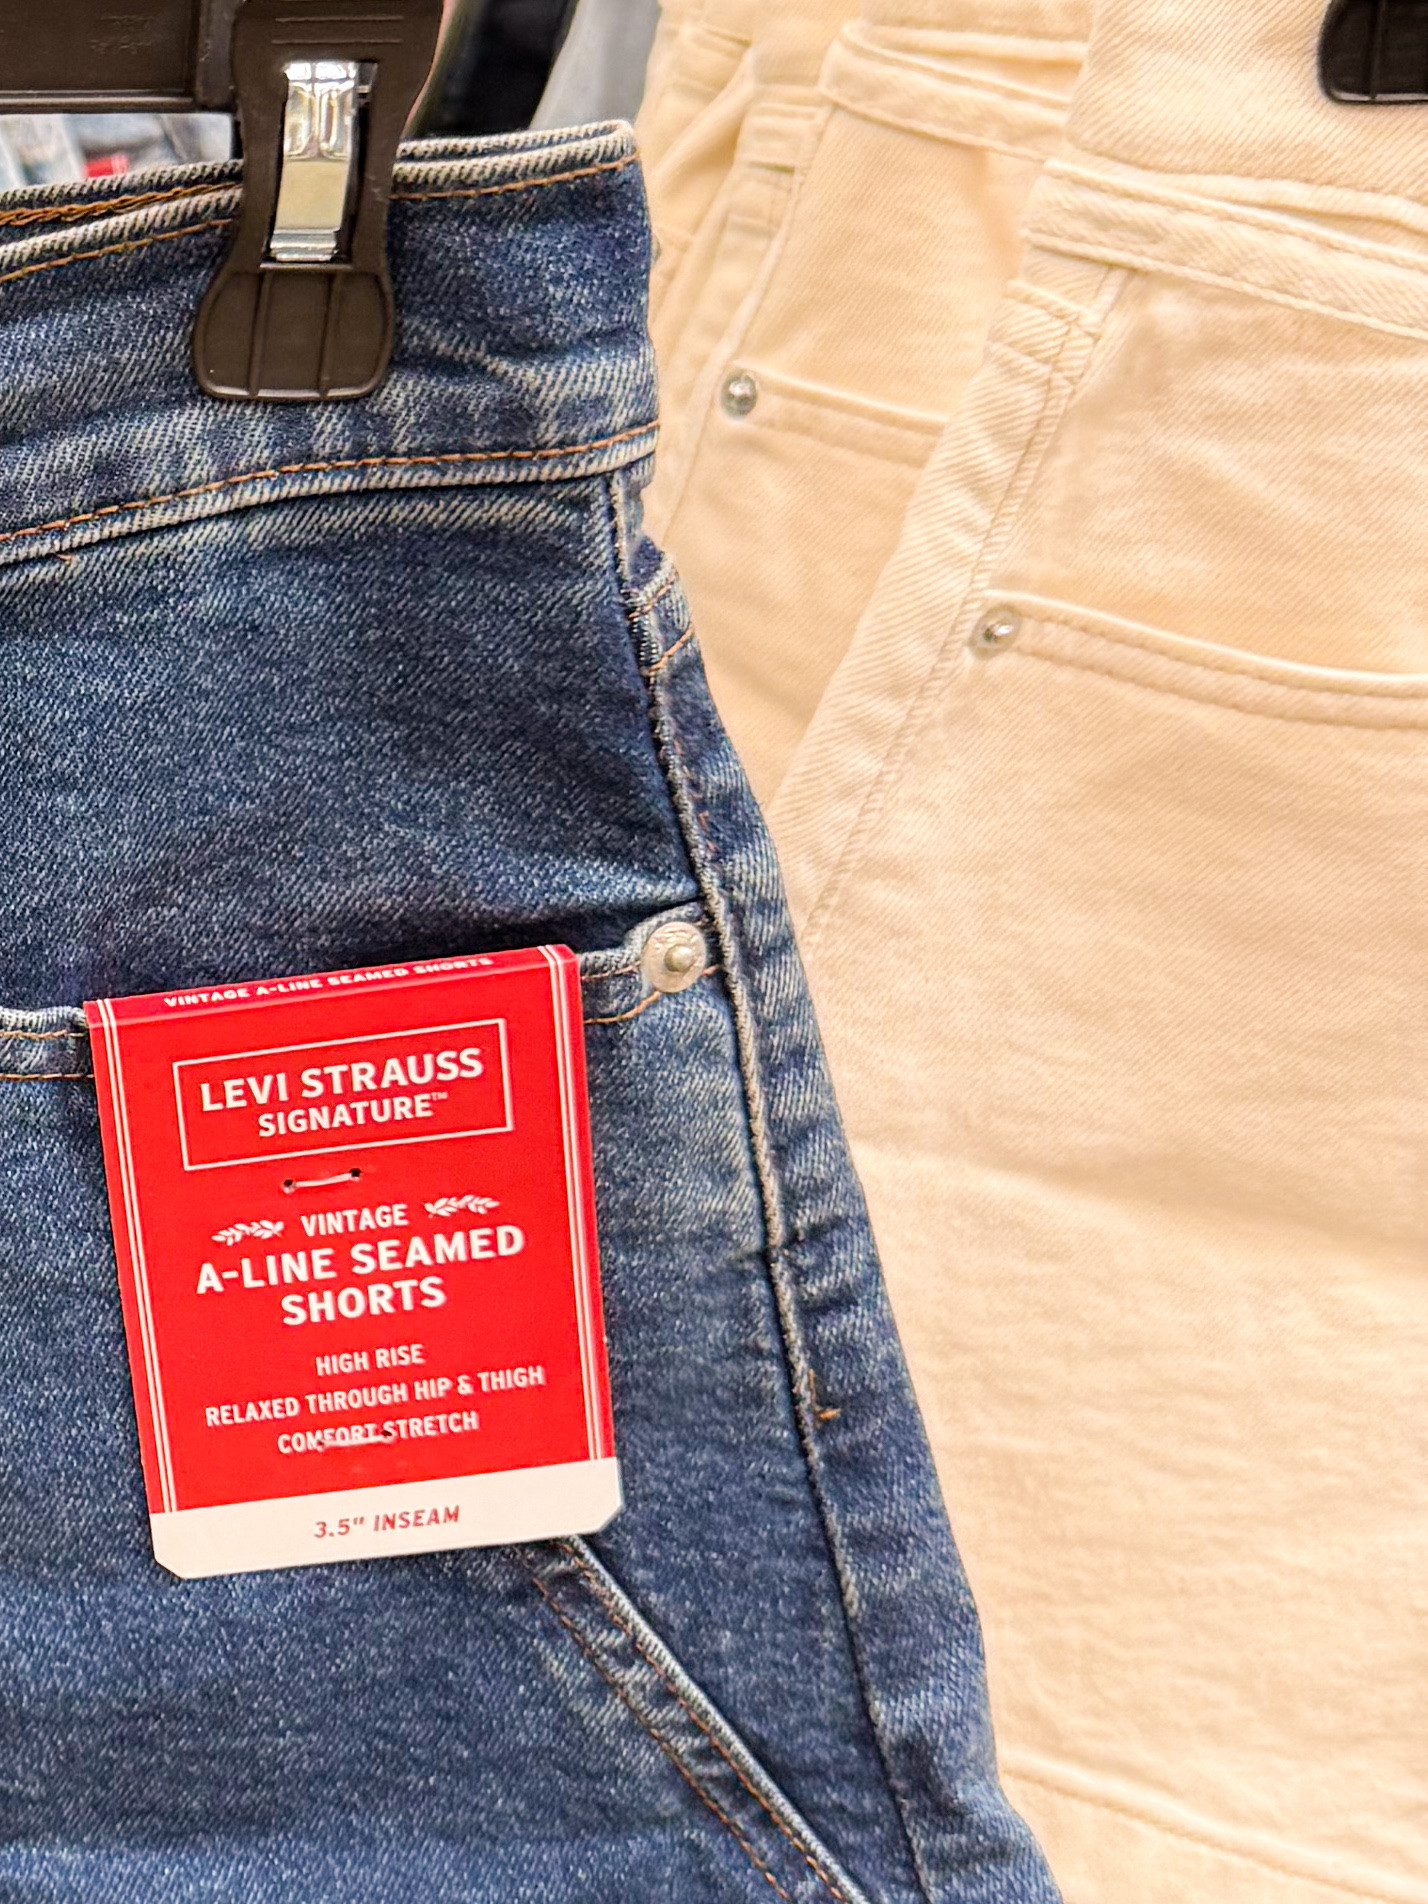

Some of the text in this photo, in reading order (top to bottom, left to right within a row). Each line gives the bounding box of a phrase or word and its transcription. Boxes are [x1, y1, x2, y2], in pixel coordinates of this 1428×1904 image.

[163, 957, 495, 1008] VINTAGE A-LINE SEAMED SHORTS
[200, 1047, 484, 1112] LEVI STRAUSS
[300, 1203, 409, 1237] VINTAGE
[196, 1224, 526, 1295] A-LINE SEAMED
[280, 1275, 447, 1326] SHORTS
[315, 1343, 426, 1377] HIGH RISE
[204, 1365, 546, 1427] RELAXED THROUGH HIP & THIGH
[277, 1410, 481, 1454] COMFORT STRETCH
[313, 1505, 461, 1539] 3.5" INSEAM
